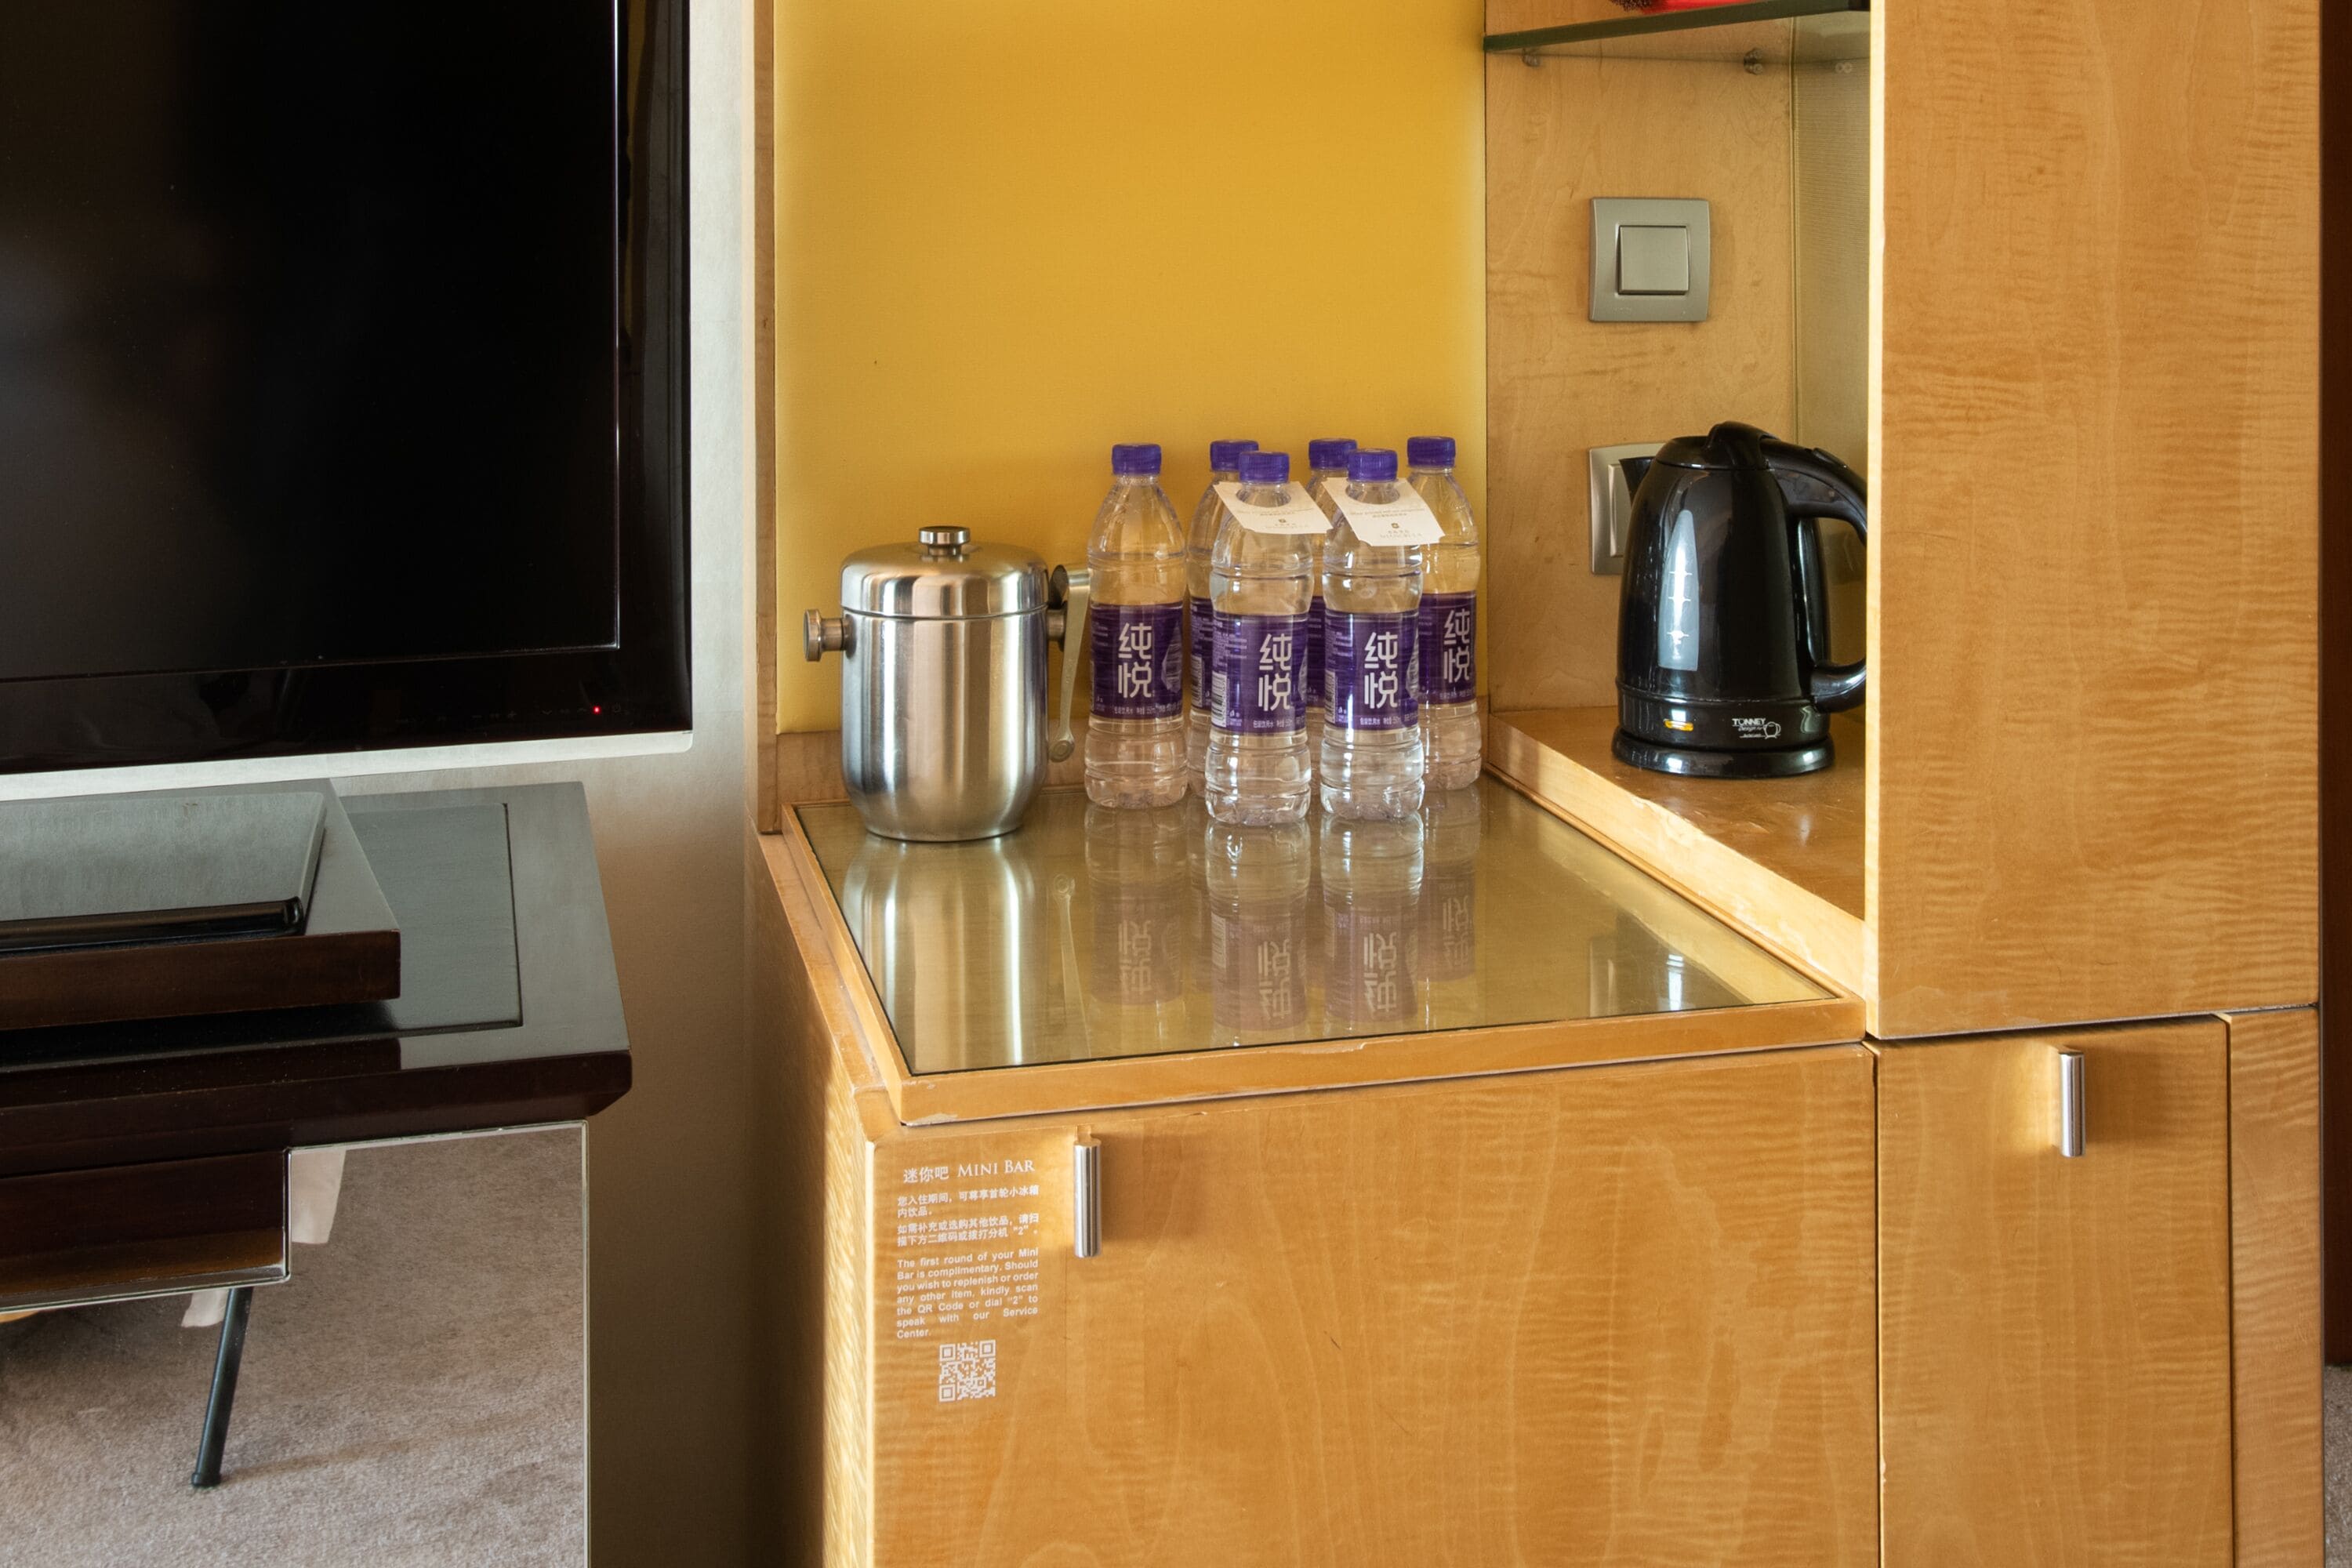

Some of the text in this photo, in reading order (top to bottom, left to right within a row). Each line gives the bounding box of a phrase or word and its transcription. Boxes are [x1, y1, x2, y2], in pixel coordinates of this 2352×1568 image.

[1443, 608, 1471, 684] 纯悦
[1118, 622, 1152, 699] 纯悦
[1258, 633, 1292, 712] 纯悦
[1363, 631, 1399, 709] 纯悦
[903, 1159, 1036, 1183] 迷你吧 MINI BAR
[897, 1247, 1039, 1269] The first round of your Mini
[897, 1259, 1039, 1280] Bar is complimentary. Should
[897, 1283, 915, 1294] you
[917, 1279, 940, 1290] wish
[953, 1275, 999, 1288] replenish
[1013, 1272, 1039, 1282] order
[897, 1295, 915, 1305] any
[920, 1291, 946, 1301] other
[980, 1285, 1010, 1296] kindly
[1015, 1283, 1038, 1293] scan
[896, 1306, 912, 1316] the
[917, 1304, 933, 1313] QR
[938, 1301, 964, 1312] Code
[968, 1300, 980, 1309] or
[985, 1297, 1003, 1308] dial
[1028, 1294, 1038, 1303] to
[896, 1305, 1038, 1329] speak with our Service
